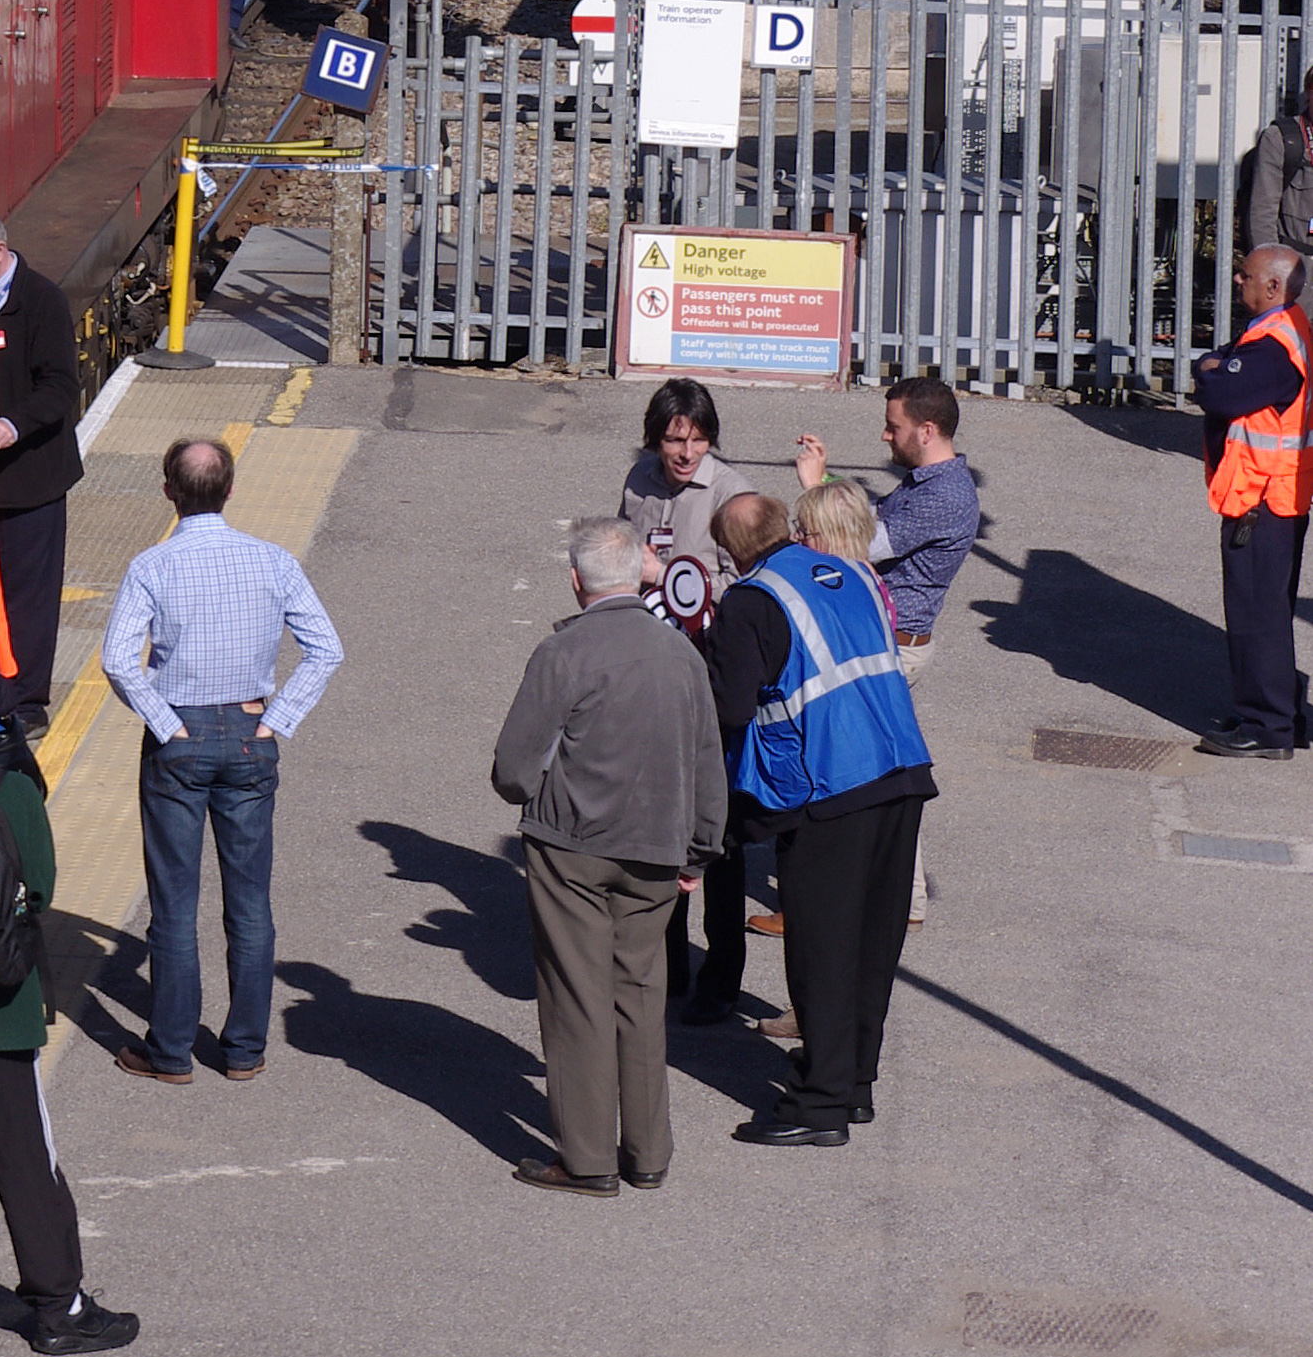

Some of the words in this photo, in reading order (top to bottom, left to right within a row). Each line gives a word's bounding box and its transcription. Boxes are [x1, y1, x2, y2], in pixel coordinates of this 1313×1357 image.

[658, 4, 680, 13] Train
[683, 6, 723, 15] operator
[657, 14, 712, 24] information
[769, 12, 804, 51] D
[337, 51, 358, 77] B
[791, 55, 811, 65] OFF
[683, 242, 747, 263] Danger
[683, 263, 713, 277] High
[718, 266, 767, 280] voltage
[681, 287, 757, 304] Passengers
[761, 292, 795, 304] must
[799, 293, 824, 306] not
[681, 304, 711, 318] pass
[716, 304, 742, 316] this
[746, 305, 782, 319] point
[681, 317, 730, 328] Offenders
[732, 320, 748, 329] will
[751, 321, 763, 330] be
[766, 322, 820, 333] prosecuted
[680, 339, 705, 349] Staff
[707, 340, 743, 351] working
[746, 342, 758, 351] on
[760, 342, 777, 352] the
[779, 343, 804, 353] track
[806, 345, 831, 354] must
[680, 350, 713, 360] comply
[716, 350, 737, 360] with
[739, 352, 770, 362] safety
[772, 353, 829, 364] instructions
[672, 569, 697, 609] C
